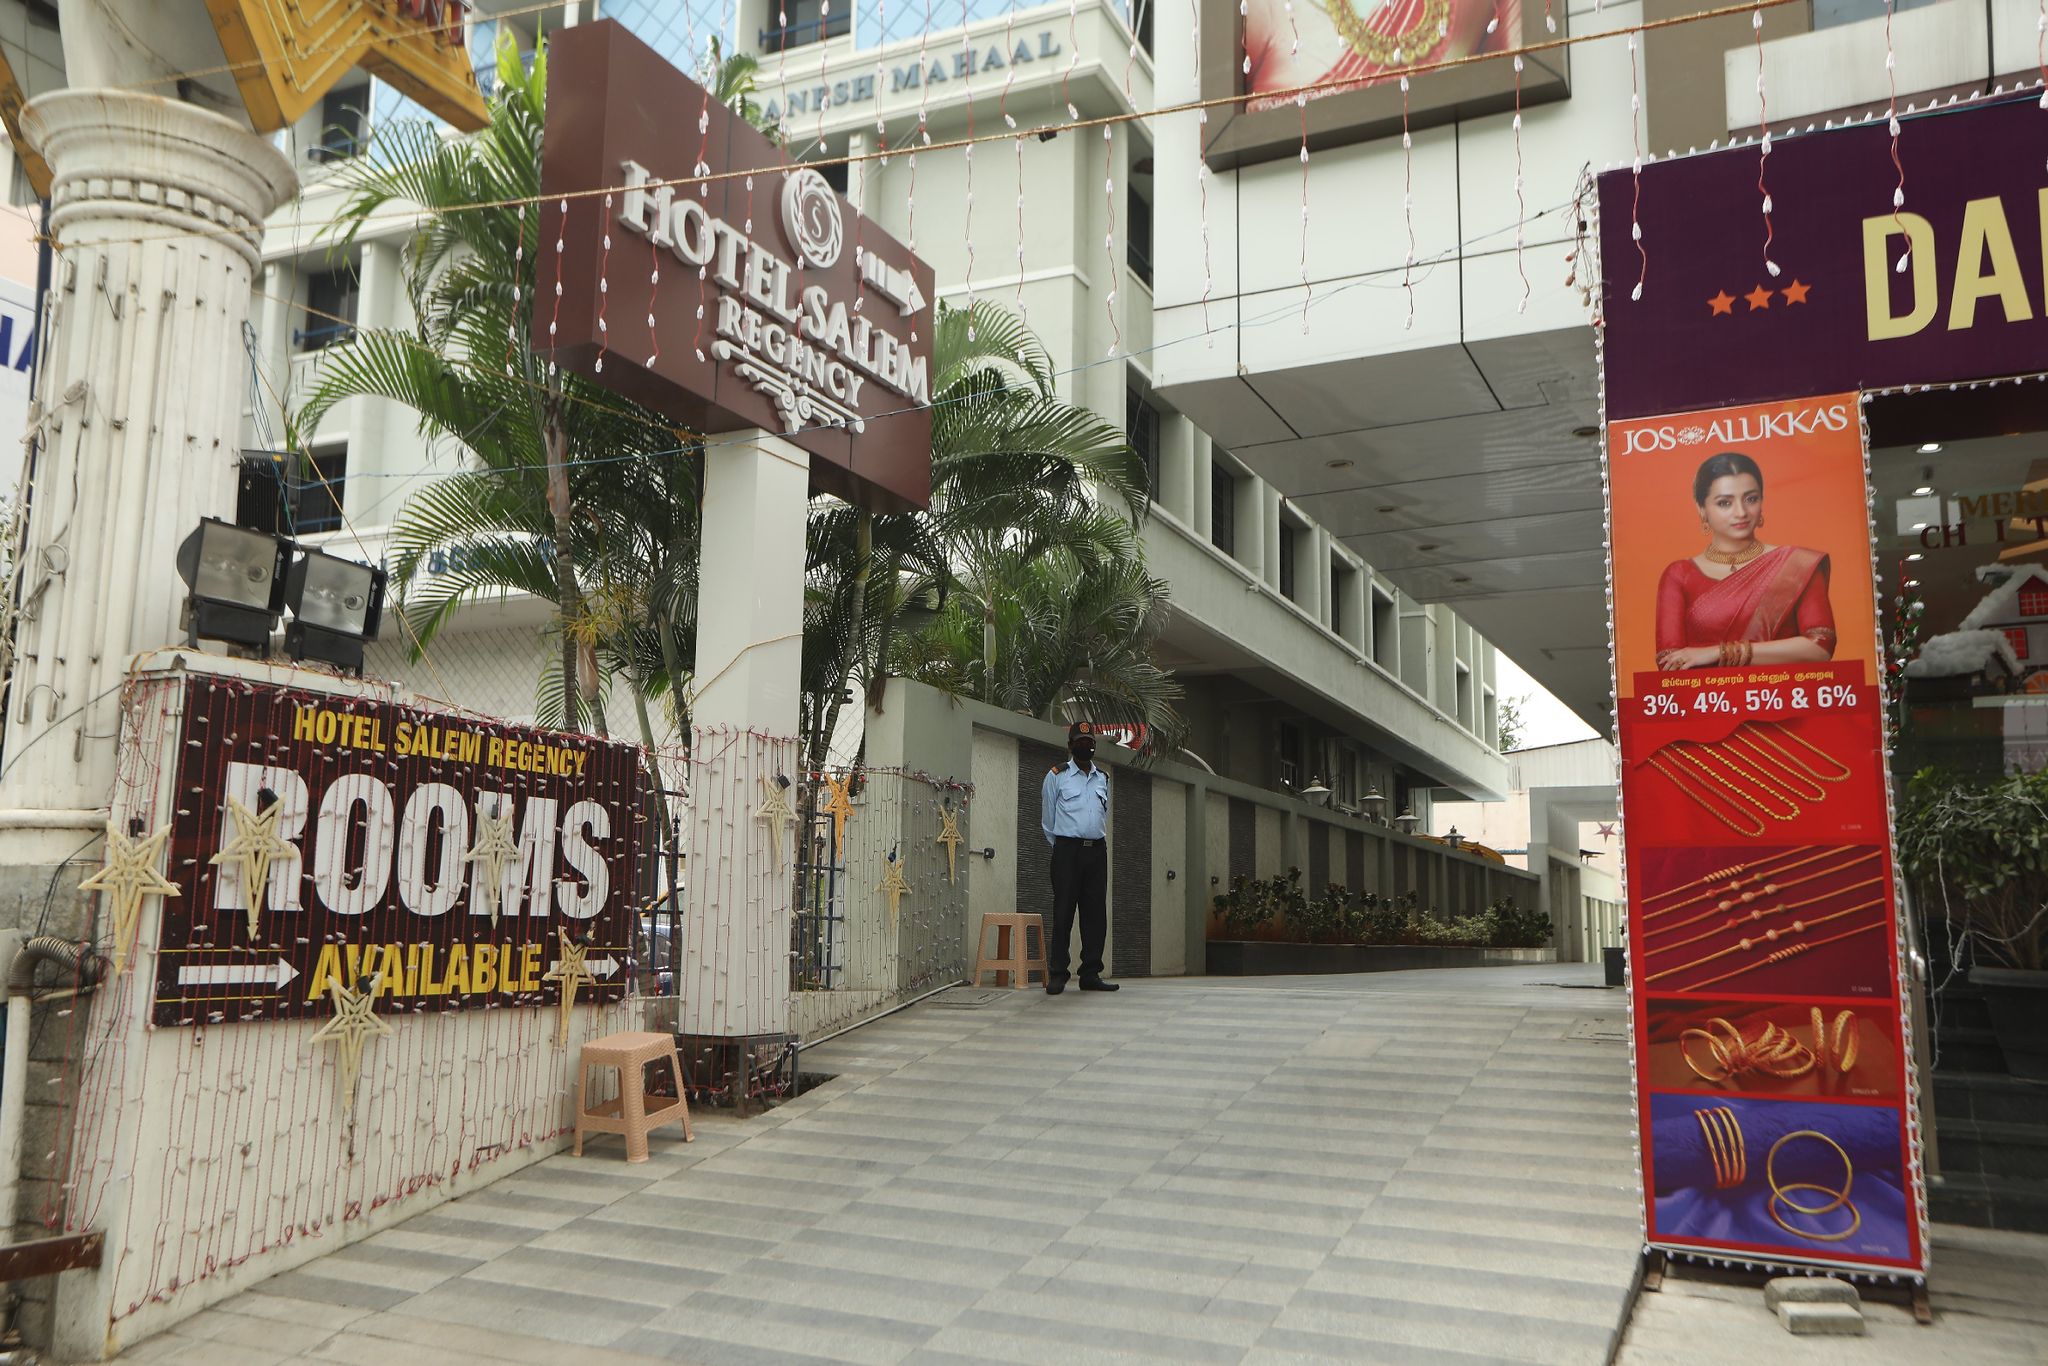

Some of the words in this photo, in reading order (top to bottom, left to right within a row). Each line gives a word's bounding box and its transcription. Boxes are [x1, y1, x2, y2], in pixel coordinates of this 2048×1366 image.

[763, 74, 874, 121] ANESH
[891, 31, 1062, 93] MAHAAL
[619, 159, 798, 324] HOTEL
[800, 285, 932, 407] SALEM
[1862, 187, 2048, 341] DA
[715, 294, 865, 408] REGENCY
[1621, 426, 1678, 456] JOS
[1705, 405, 1849, 444] ALUKKAS
[293, 706, 386, 752] HOTEL
[394, 721, 482, 765] SALEM
[487, 736, 587, 776] REGENCY
[1643, 694, 1686, 717] 3%,
[1693, 691, 1738, 714] 4%,
[1745, 688, 1784, 711] 5%
[1791, 687, 1810, 709] &
[1817, 685, 1857, 708] 6%
[213, 761, 612, 920] ROOMS
[308, 942, 543, 1000] AVAILABLE
